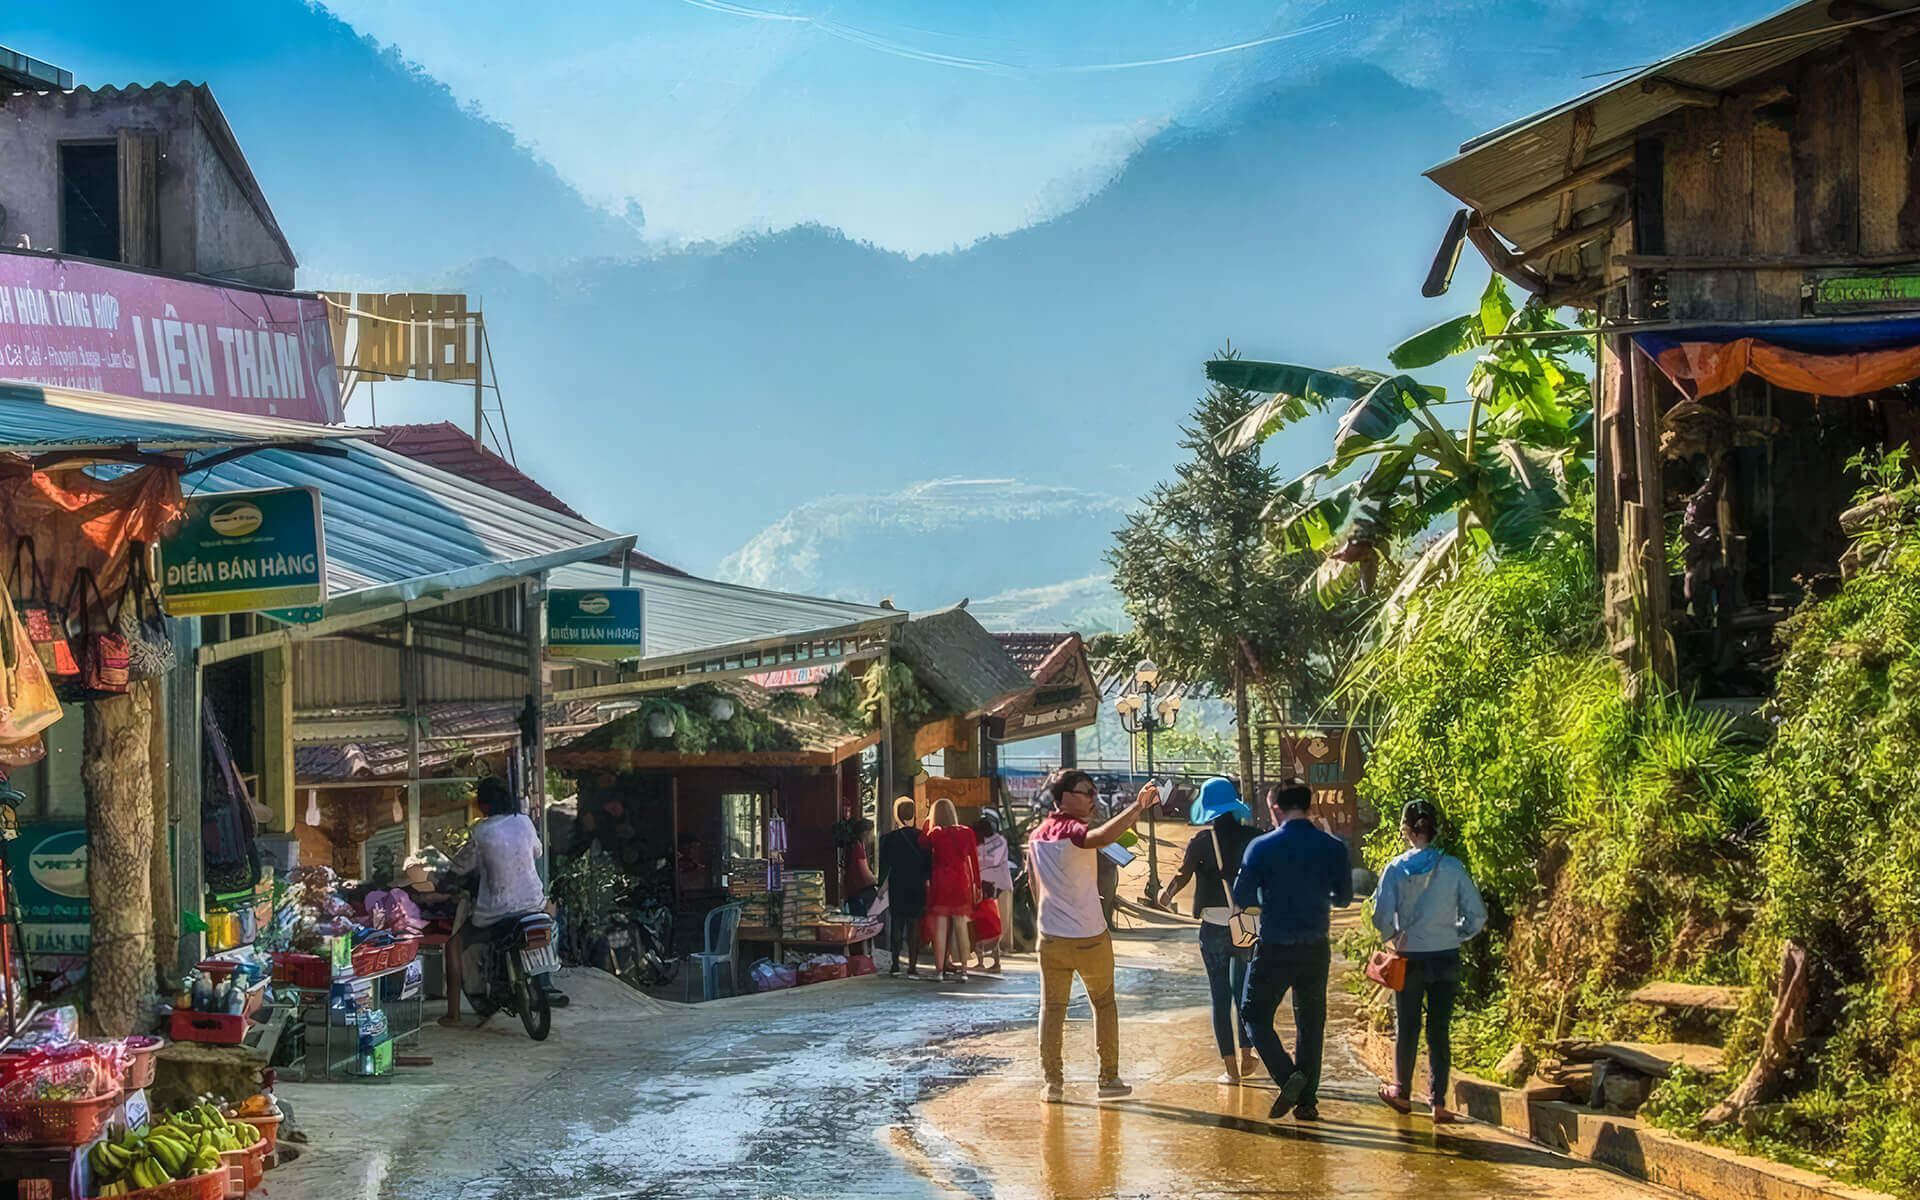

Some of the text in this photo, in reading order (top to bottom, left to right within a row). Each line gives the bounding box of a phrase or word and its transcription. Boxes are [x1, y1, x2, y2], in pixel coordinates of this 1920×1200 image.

[132, 304, 215, 396] LIÊN
[167, 552, 316, 586] ĐIỂM BÁN HÀNG
[1316, 789, 1345, 805] TEL
